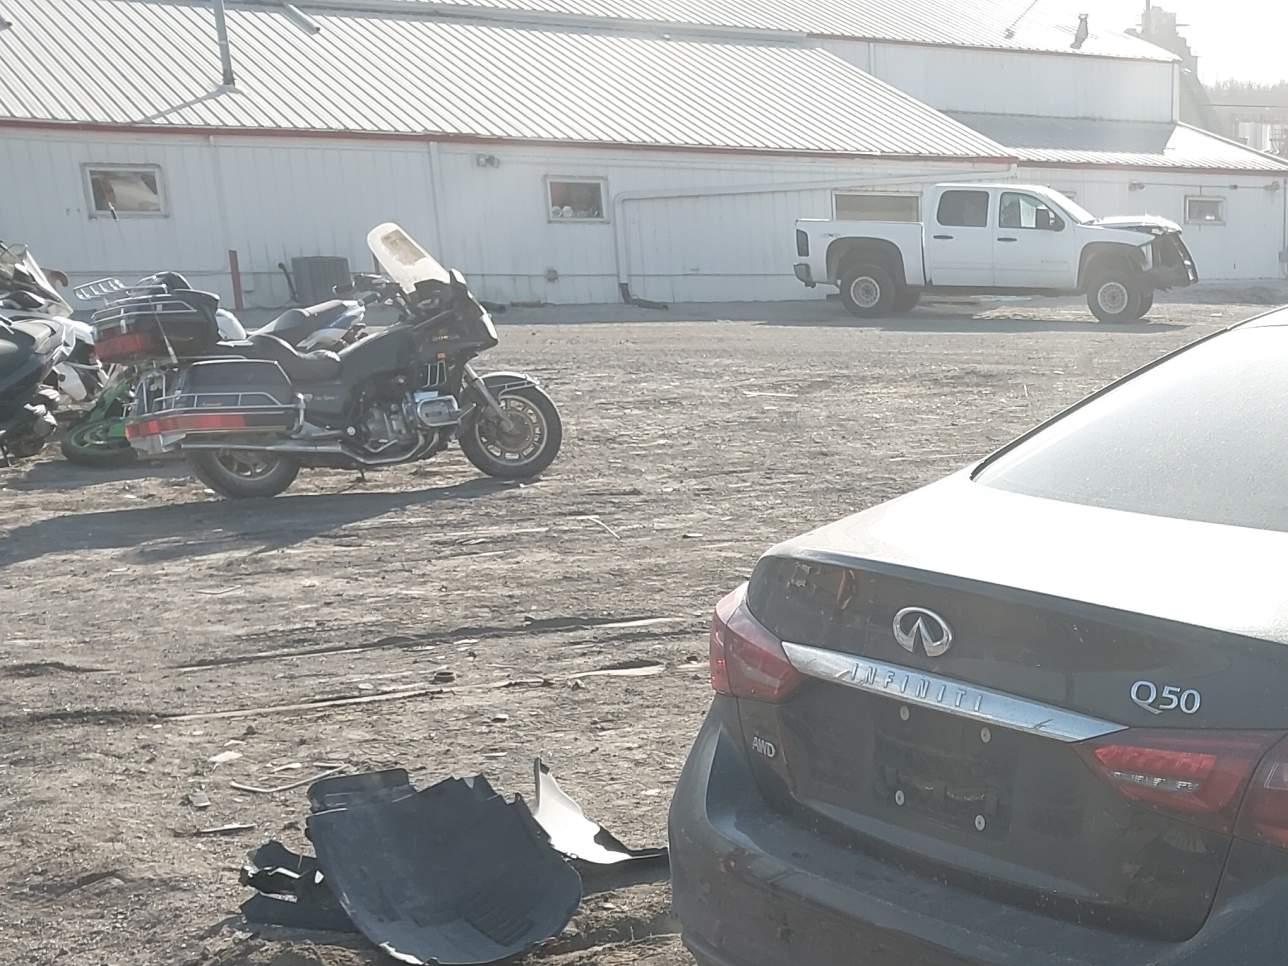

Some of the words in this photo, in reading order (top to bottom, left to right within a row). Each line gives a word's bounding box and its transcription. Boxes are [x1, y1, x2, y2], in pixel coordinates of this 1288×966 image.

[850, 662, 983, 713] INFINITI
[1130, 680, 1201, 715] Q50
[752, 736, 776, 758] AWD
